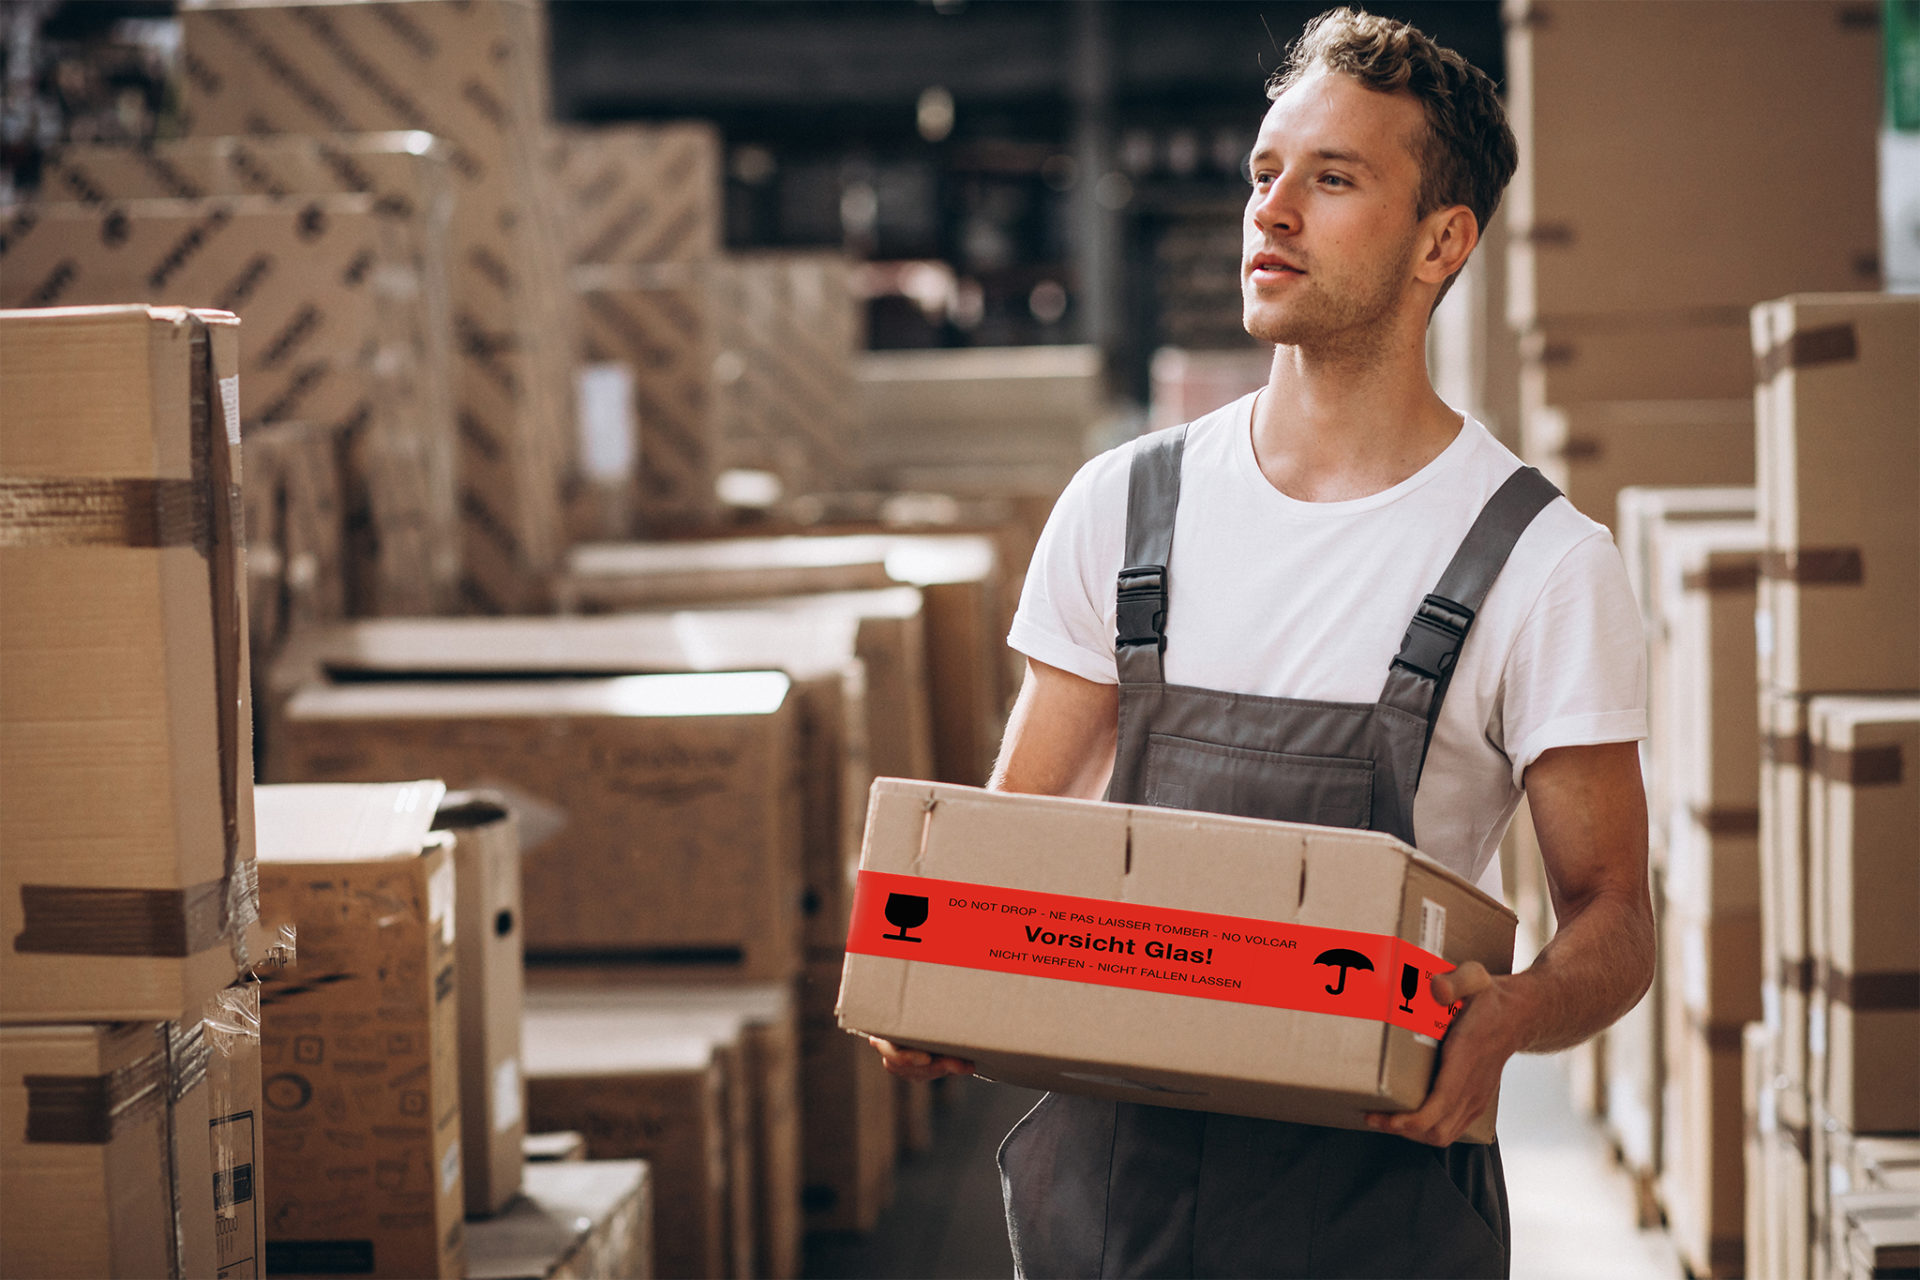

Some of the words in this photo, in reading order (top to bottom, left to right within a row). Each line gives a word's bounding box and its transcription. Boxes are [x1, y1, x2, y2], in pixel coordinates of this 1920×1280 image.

[948, 897, 968, 908] DO
[970, 900, 998, 912] NOT
[1000, 903, 1037, 916] DROP
[1049, 910, 1067, 921] NE
[1070, 912, 1095, 925] PAS
[1098, 916, 1151, 931] LAISSER
[1154, 923, 1209, 939] TOMBER
[1221, 931, 1241, 943] NO
[1244, 935, 1297, 950] VOLCAR
[1024, 925, 1136, 956] Vorsicht
[1144, 940, 1213, 965] Glas!
[989, 948, 1028, 962] NICHT
[1031, 953, 1085, 969] WERFEN
[1097, 962, 1138, 976] NICHT
[1140, 967, 1188, 982] FALLEN
[1191, 974, 1242, 989] LASSEN
